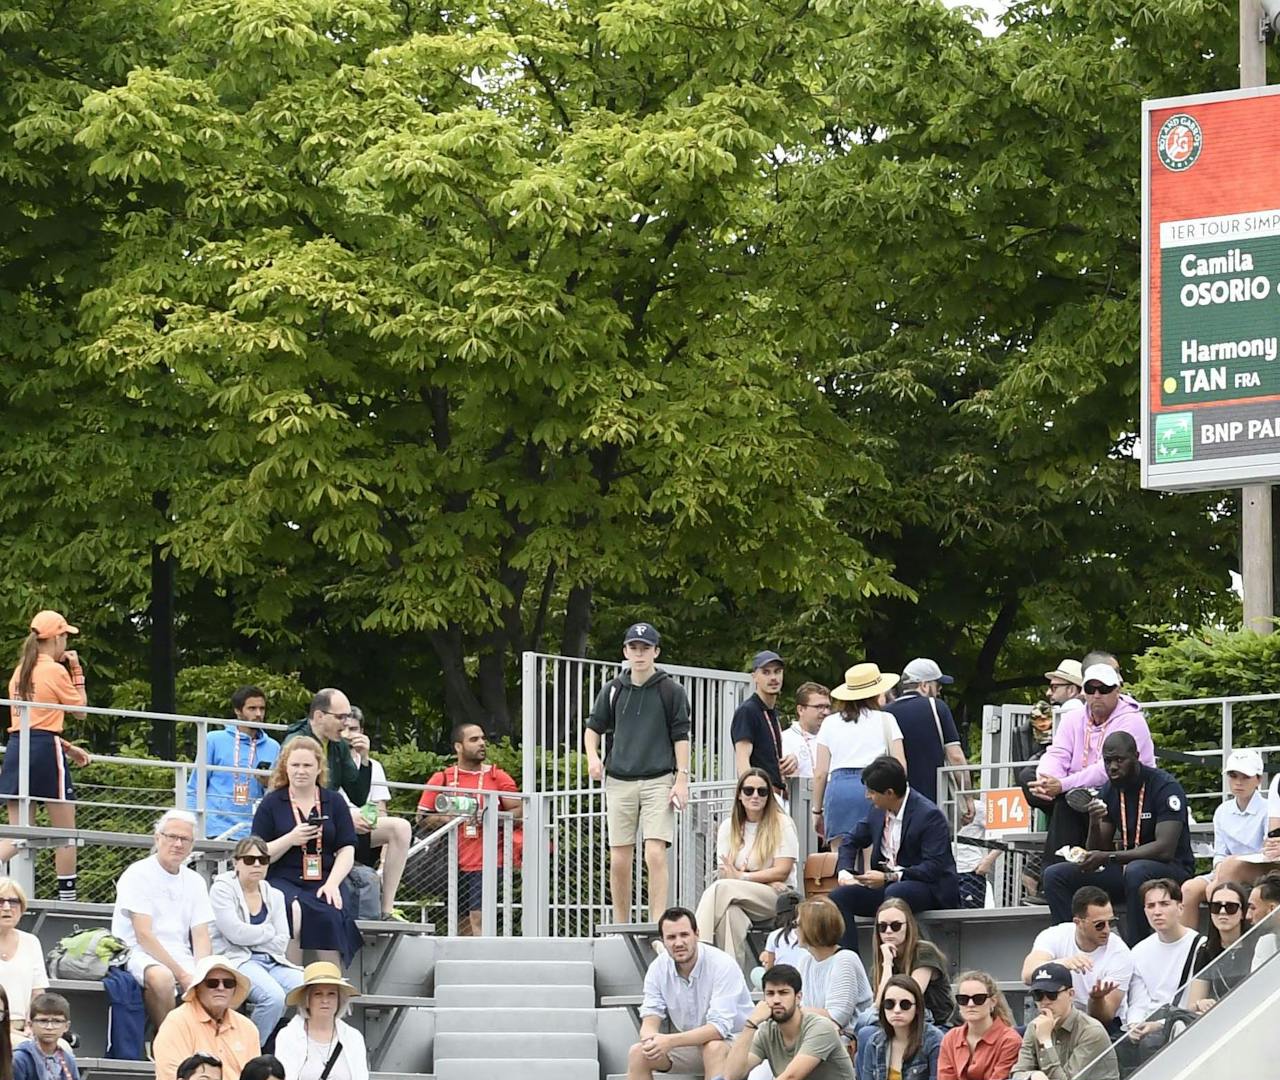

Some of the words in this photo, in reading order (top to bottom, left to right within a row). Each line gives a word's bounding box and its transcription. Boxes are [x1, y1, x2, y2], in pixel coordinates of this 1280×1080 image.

[1171, 225, 1196, 240] 1ER
[1201, 219, 1240, 238] TOUR
[1180, 248, 1254, 278] Camila
[1180, 276, 1270, 307] OSORIO
[1181, 337, 1277, 364] Harmony
[1180, 366, 1227, 394] TAN
[1234, 371, 1261, 388] FRA
[1201, 421, 1243, 444] BNP
[997, 796, 1024, 823] 14
